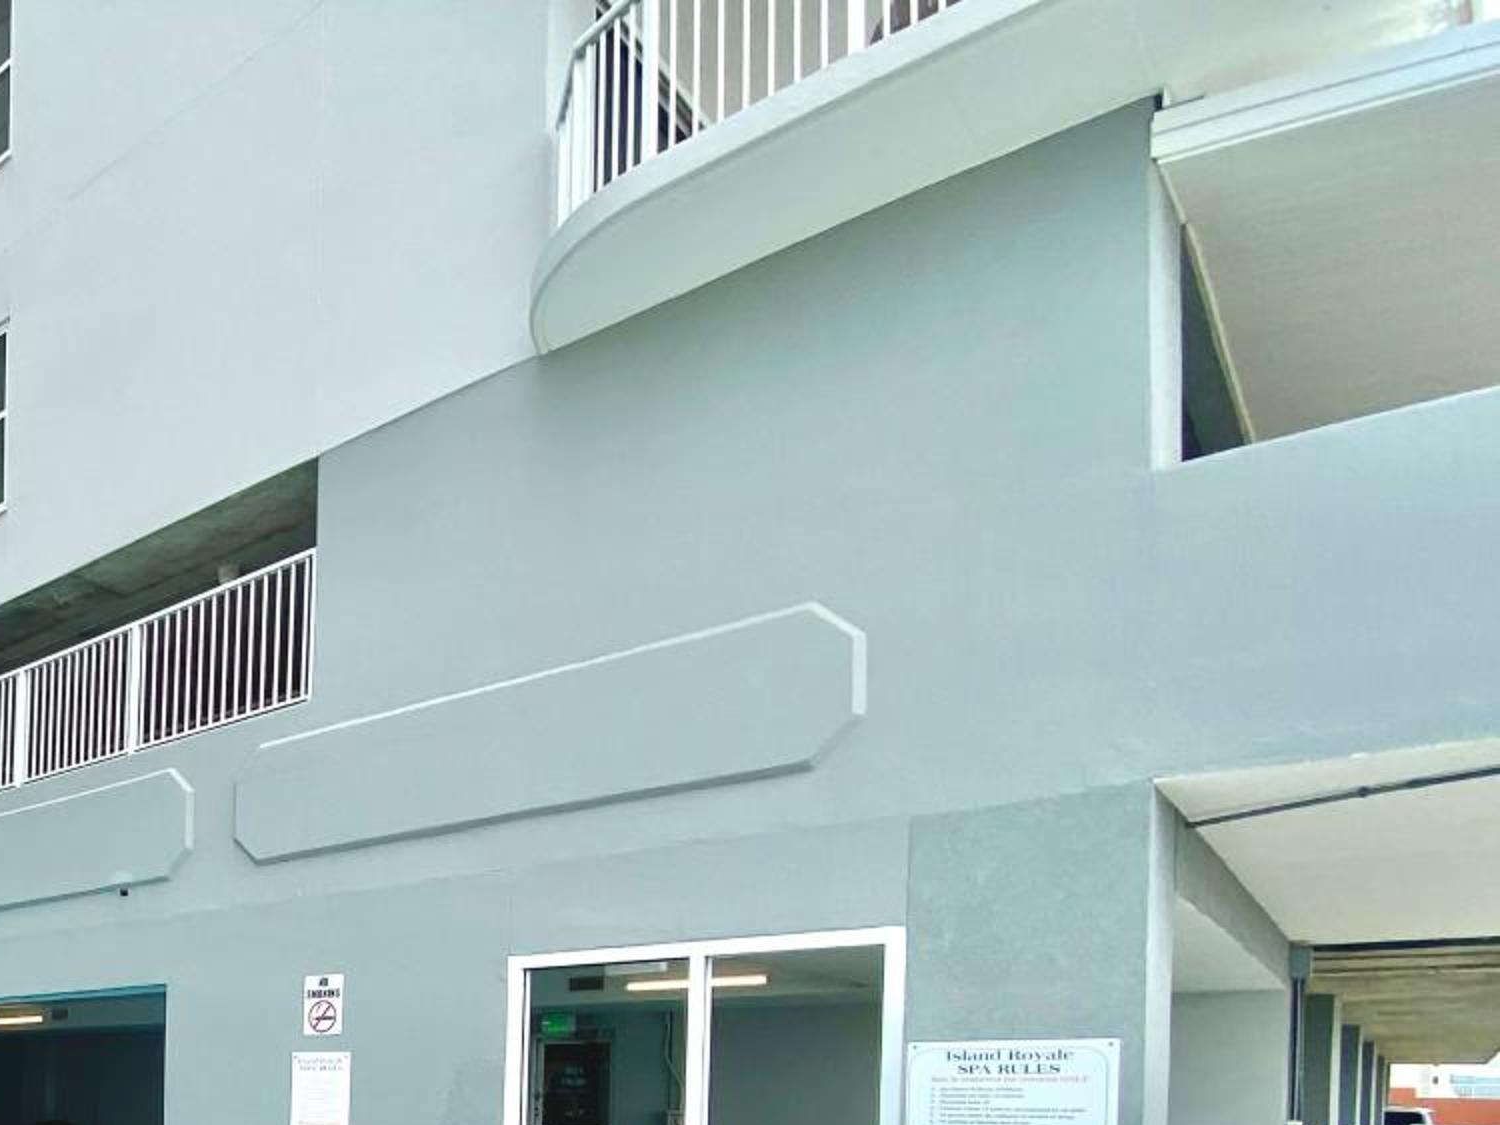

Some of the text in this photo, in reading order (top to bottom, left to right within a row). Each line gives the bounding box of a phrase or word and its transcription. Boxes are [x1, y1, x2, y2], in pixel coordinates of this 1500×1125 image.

[946, 1049, 1075, 1063] Island Royale
[957, 1063, 1061, 1075] SPA RULES
